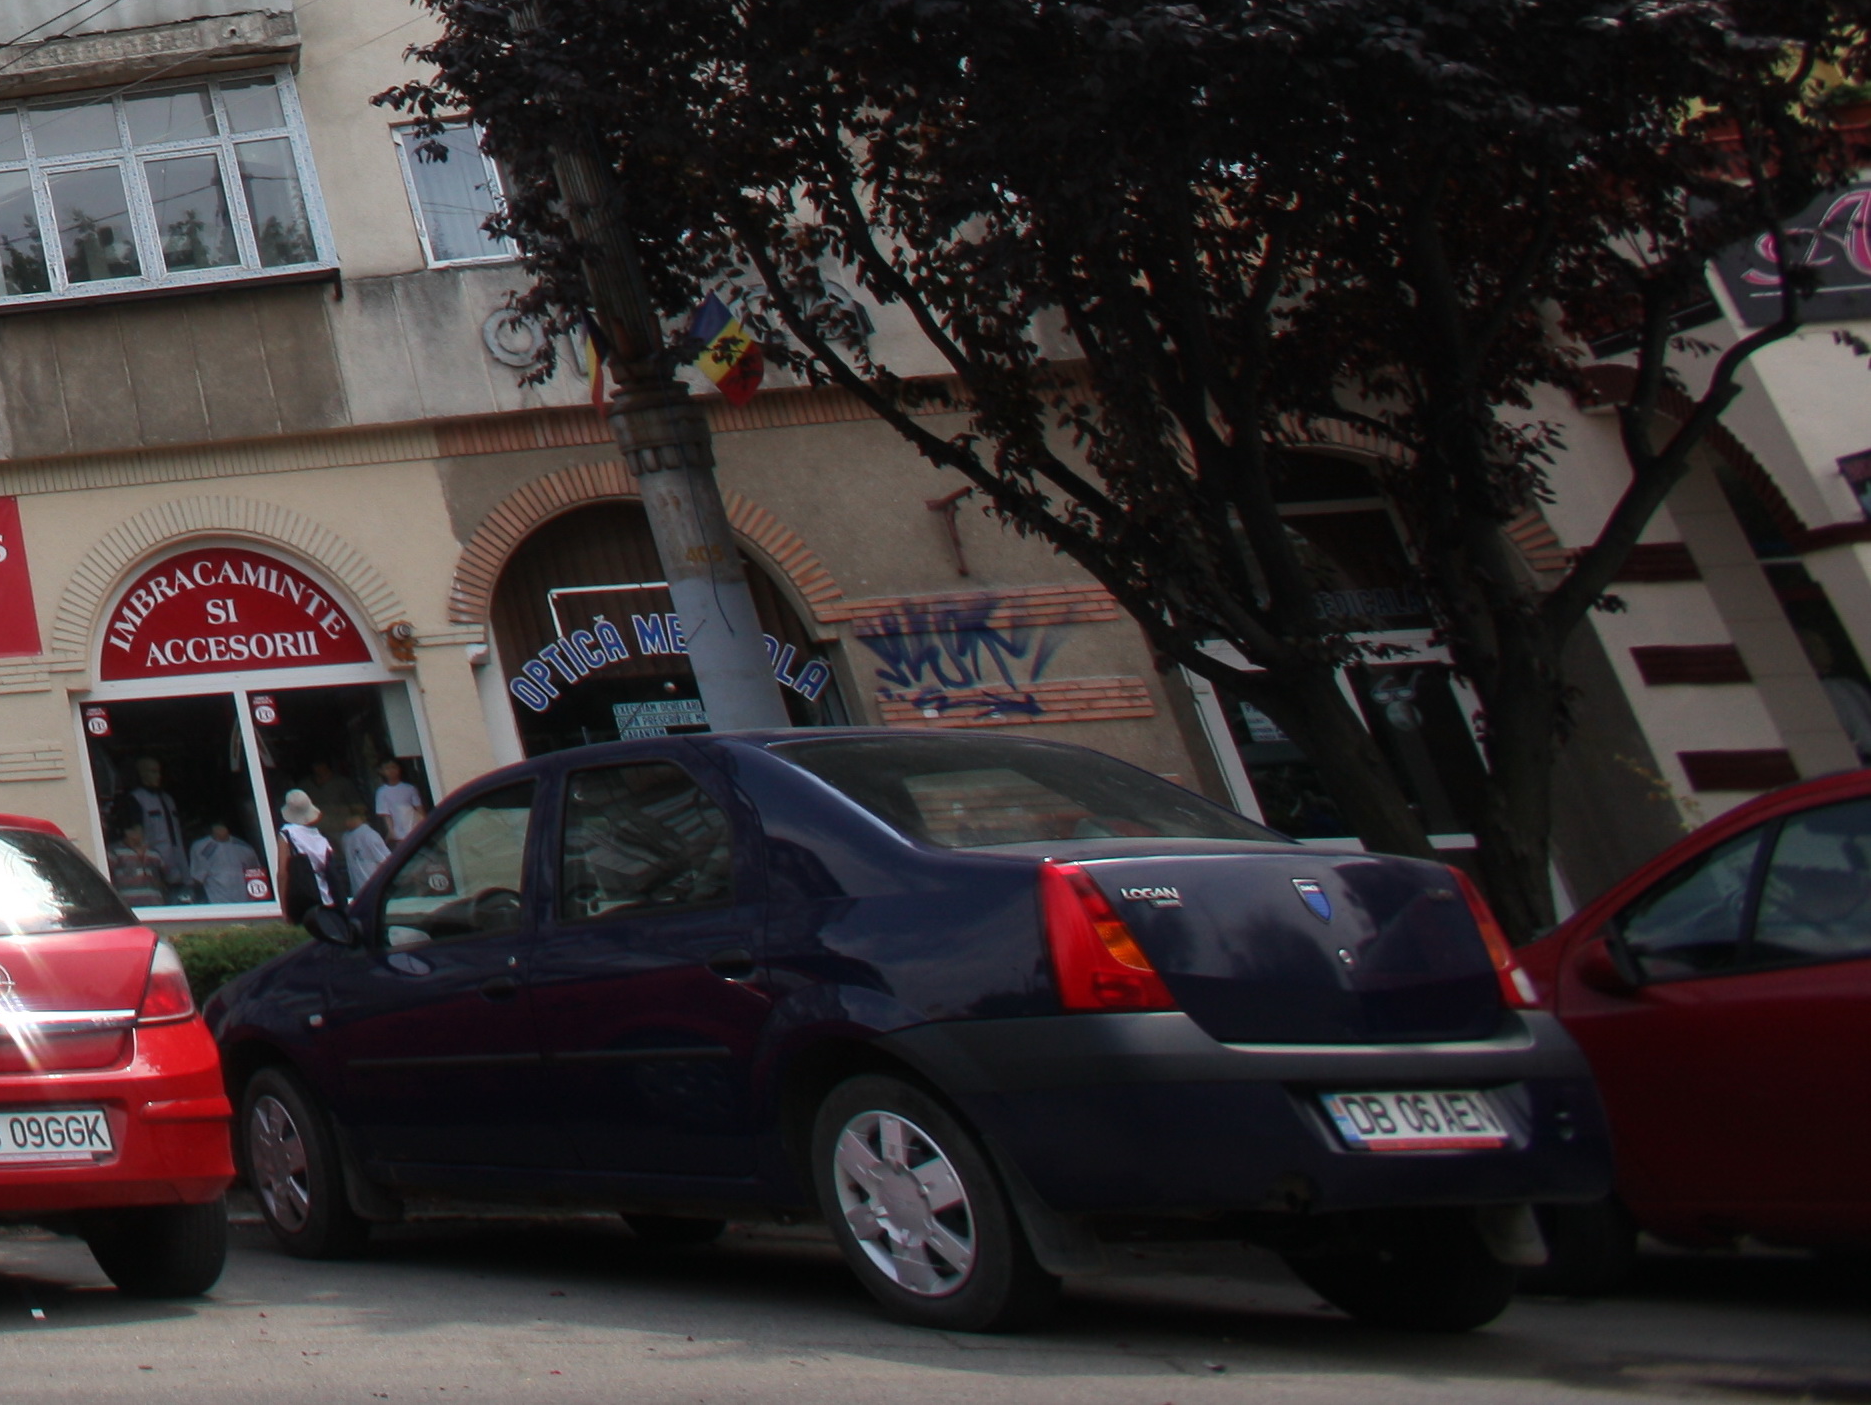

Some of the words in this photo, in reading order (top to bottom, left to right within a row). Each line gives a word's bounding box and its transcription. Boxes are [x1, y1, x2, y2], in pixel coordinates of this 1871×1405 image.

[108, 559, 348, 654] IMBRACAMINTE
[205, 598, 240, 625] SI
[145, 630, 321, 668] ACCESORII
[509, 613, 630, 713] OPTICĂ
[1120, 886, 1180, 900] LOGAN
[9, 1114, 108, 1148] 09GGK
[1339, 1095, 1398, 1135] DB
[1394, 1093, 1441, 1133] 06
